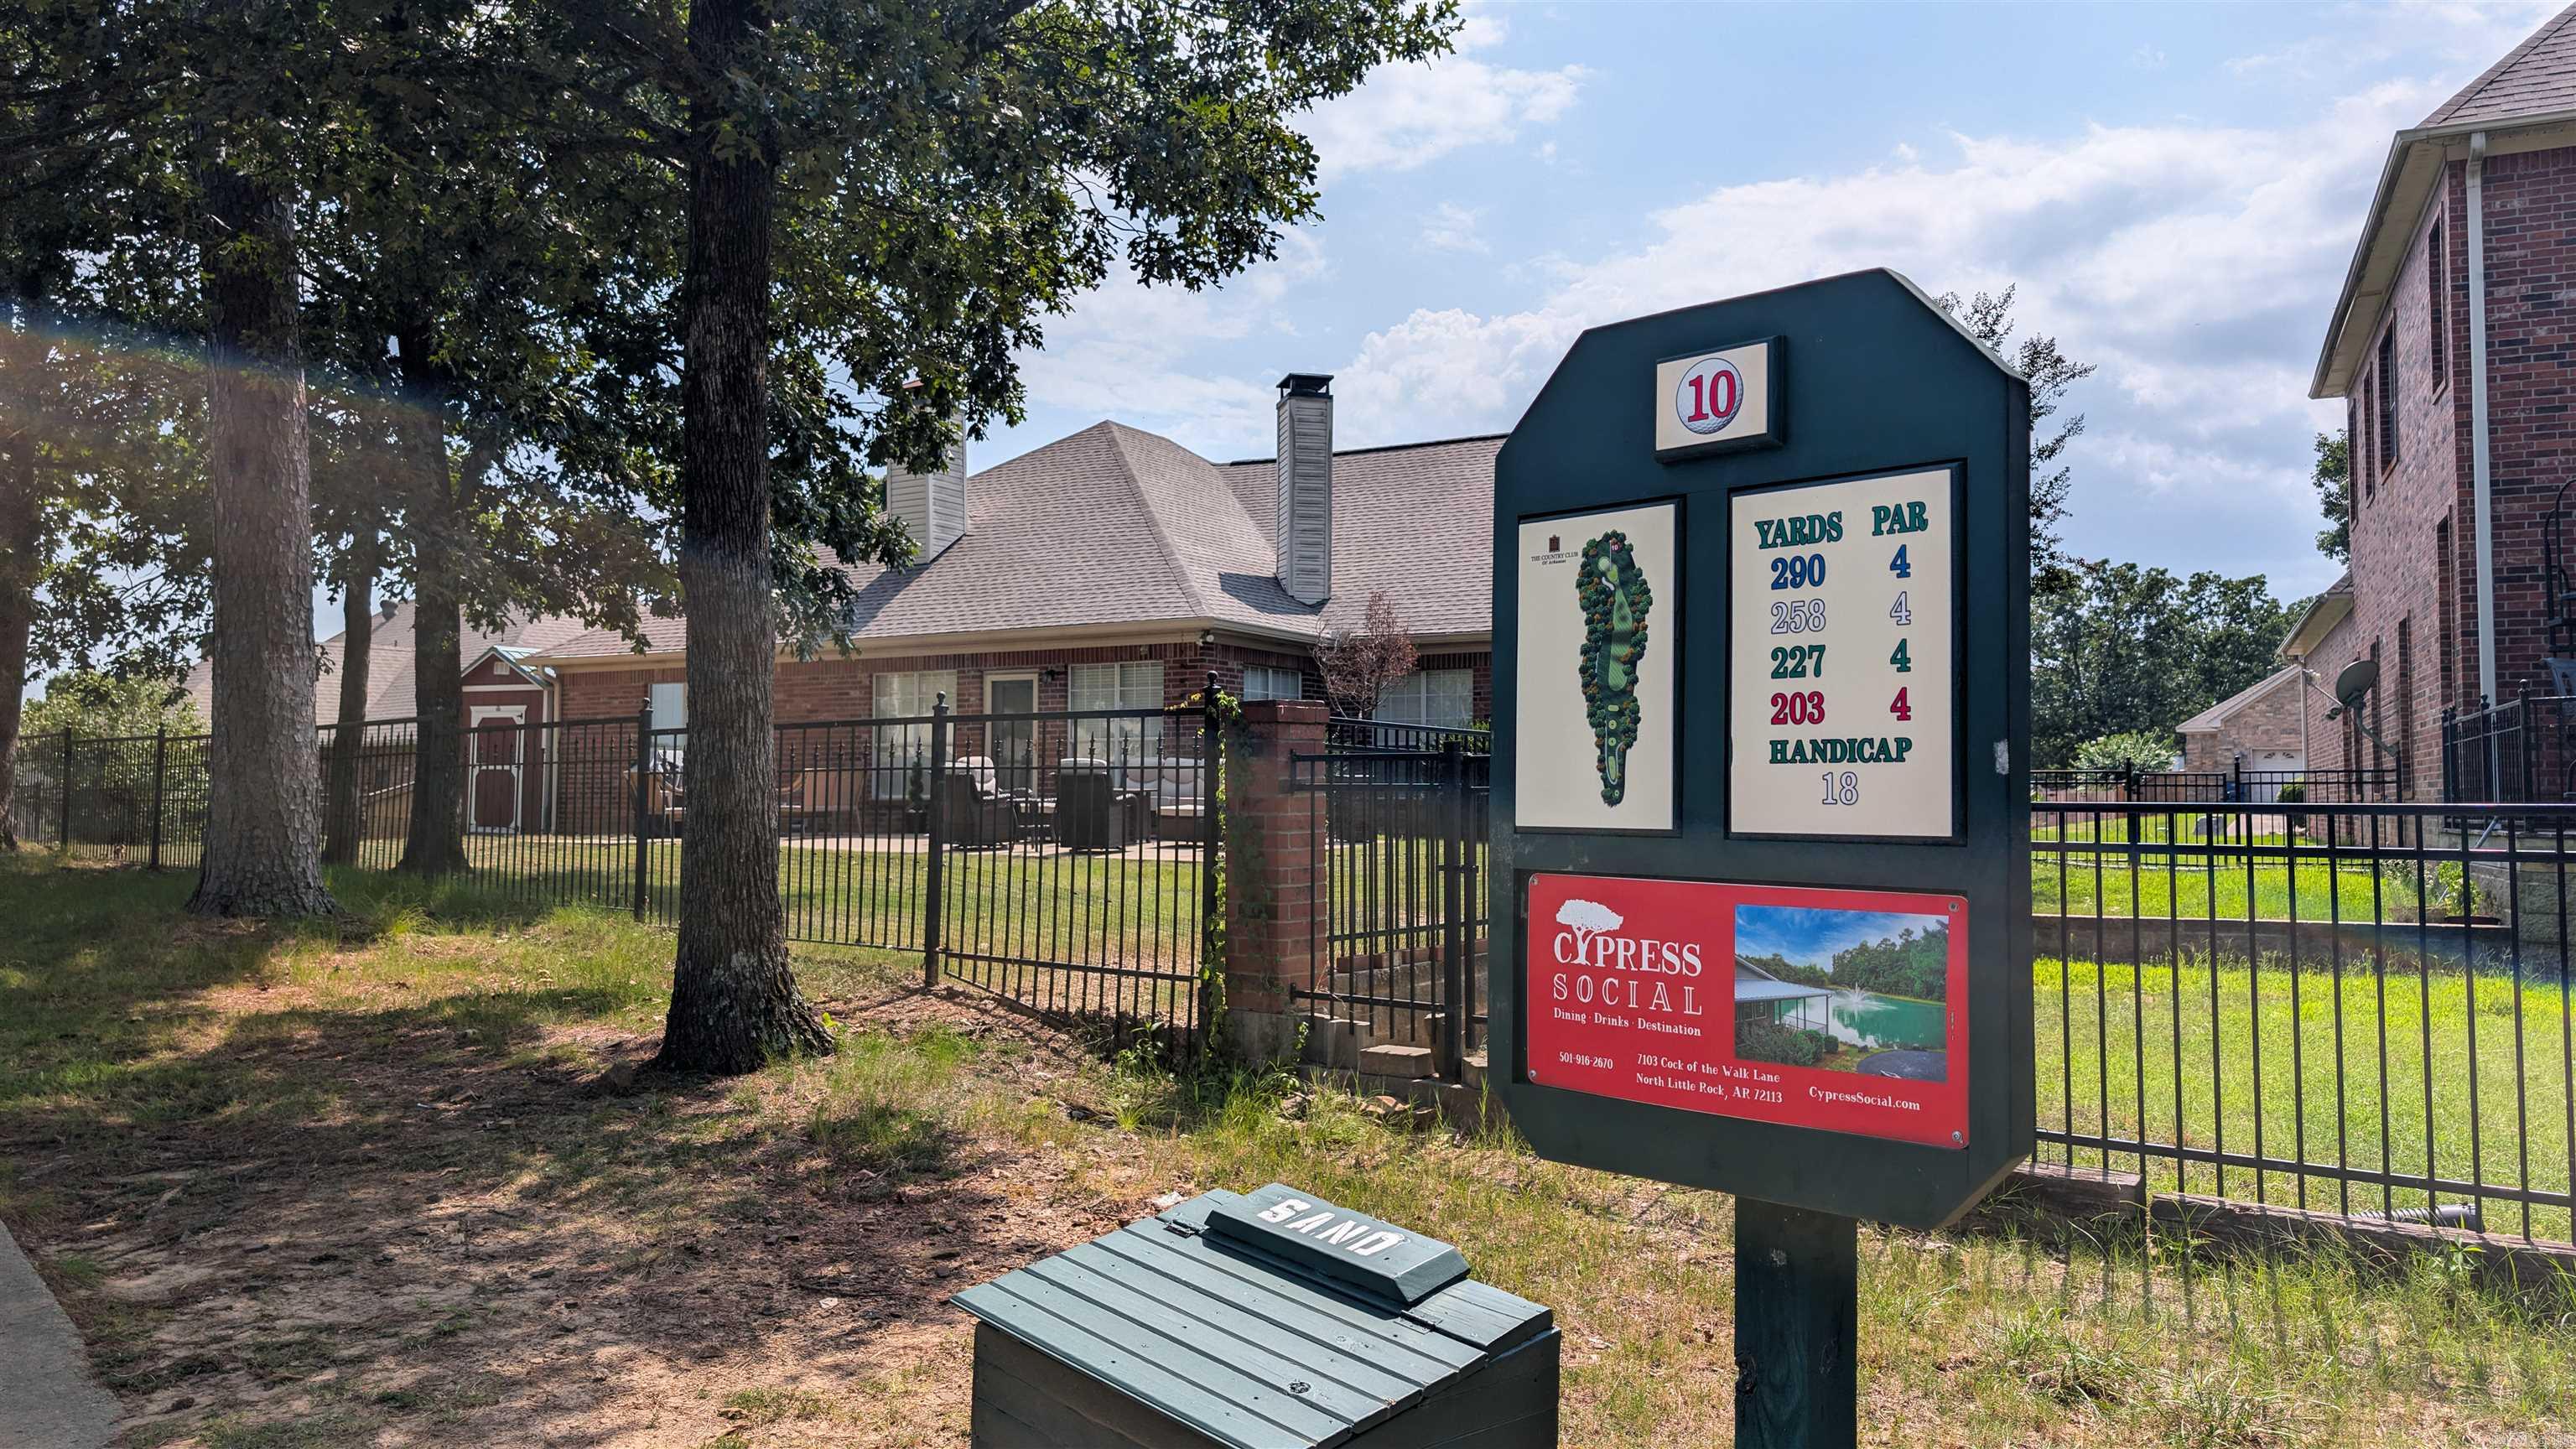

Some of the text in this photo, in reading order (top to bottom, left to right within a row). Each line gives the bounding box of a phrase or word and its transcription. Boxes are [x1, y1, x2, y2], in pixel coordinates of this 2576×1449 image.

[1687, 370, 1737, 423] 10
[1755, 501, 1929, 549] YARDS PAR
[1541, 553, 1565, 561] COUNTRY
[1770, 544, 1911, 590] 290 4
[1770, 591, 1911, 634] 258 4
[1770, 638, 1911, 679] 227 4
[1770, 687, 1911, 725] 203 4
[1769, 738, 1913, 764] HANDICAP
[1822, 771, 1858, 805] 18
[1554, 932, 1702, 977] CYPRESS
[1553, 973, 1702, 1015] SOCIAL
[1554, 1007, 1701, 1036] Dining Drinks Destination
[1559, 1052, 1613, 1070] 501-916-2670
[1637, 1054, 1781, 1083] 7103 Cock of the Walk Lane
[1636, 1072, 1783, 1104] North Little Rock, AR 72113
[1809, 1086, 1920, 1111] CypressSocial.com
[1258, 1198, 1410, 1256] SAND
